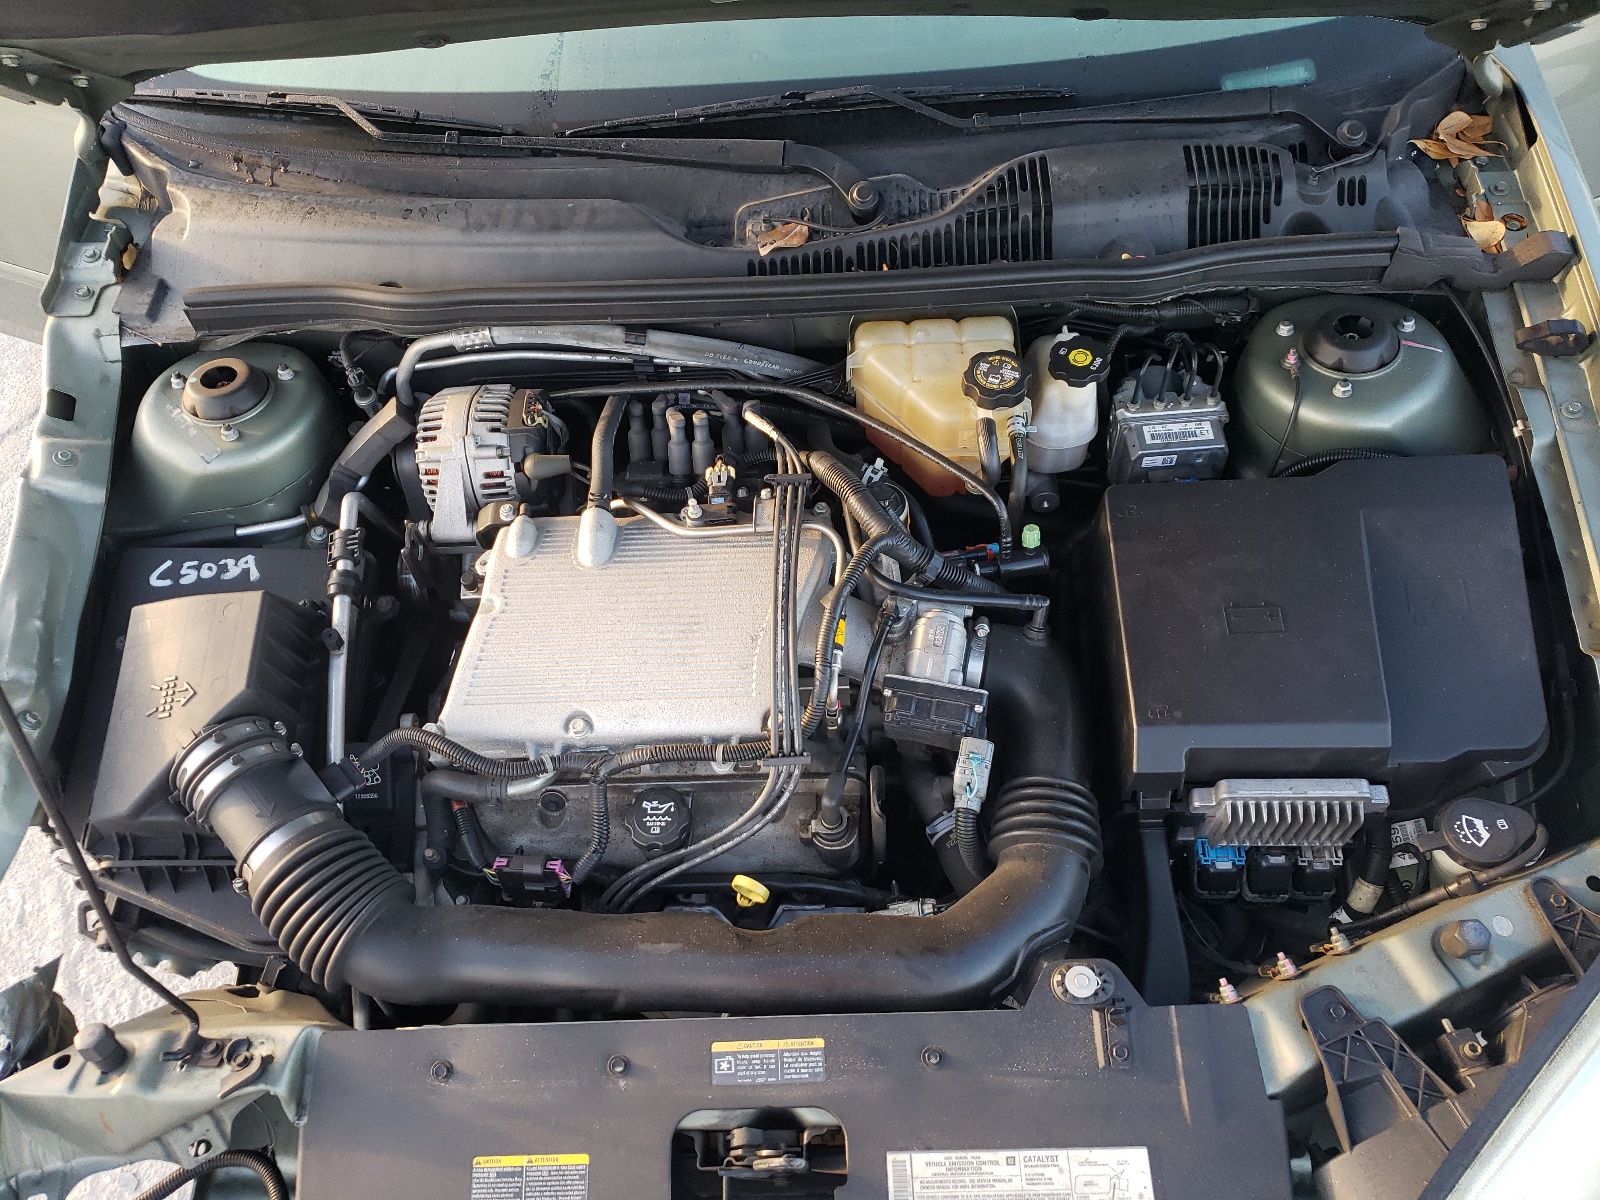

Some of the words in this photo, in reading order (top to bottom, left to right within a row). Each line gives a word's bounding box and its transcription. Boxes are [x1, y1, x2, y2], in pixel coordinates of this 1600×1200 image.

[743, 359, 780, 370] GOODYEAR
[148, 554, 261, 587] C5039
[1023, 1155, 1059, 1163] CATALYST
